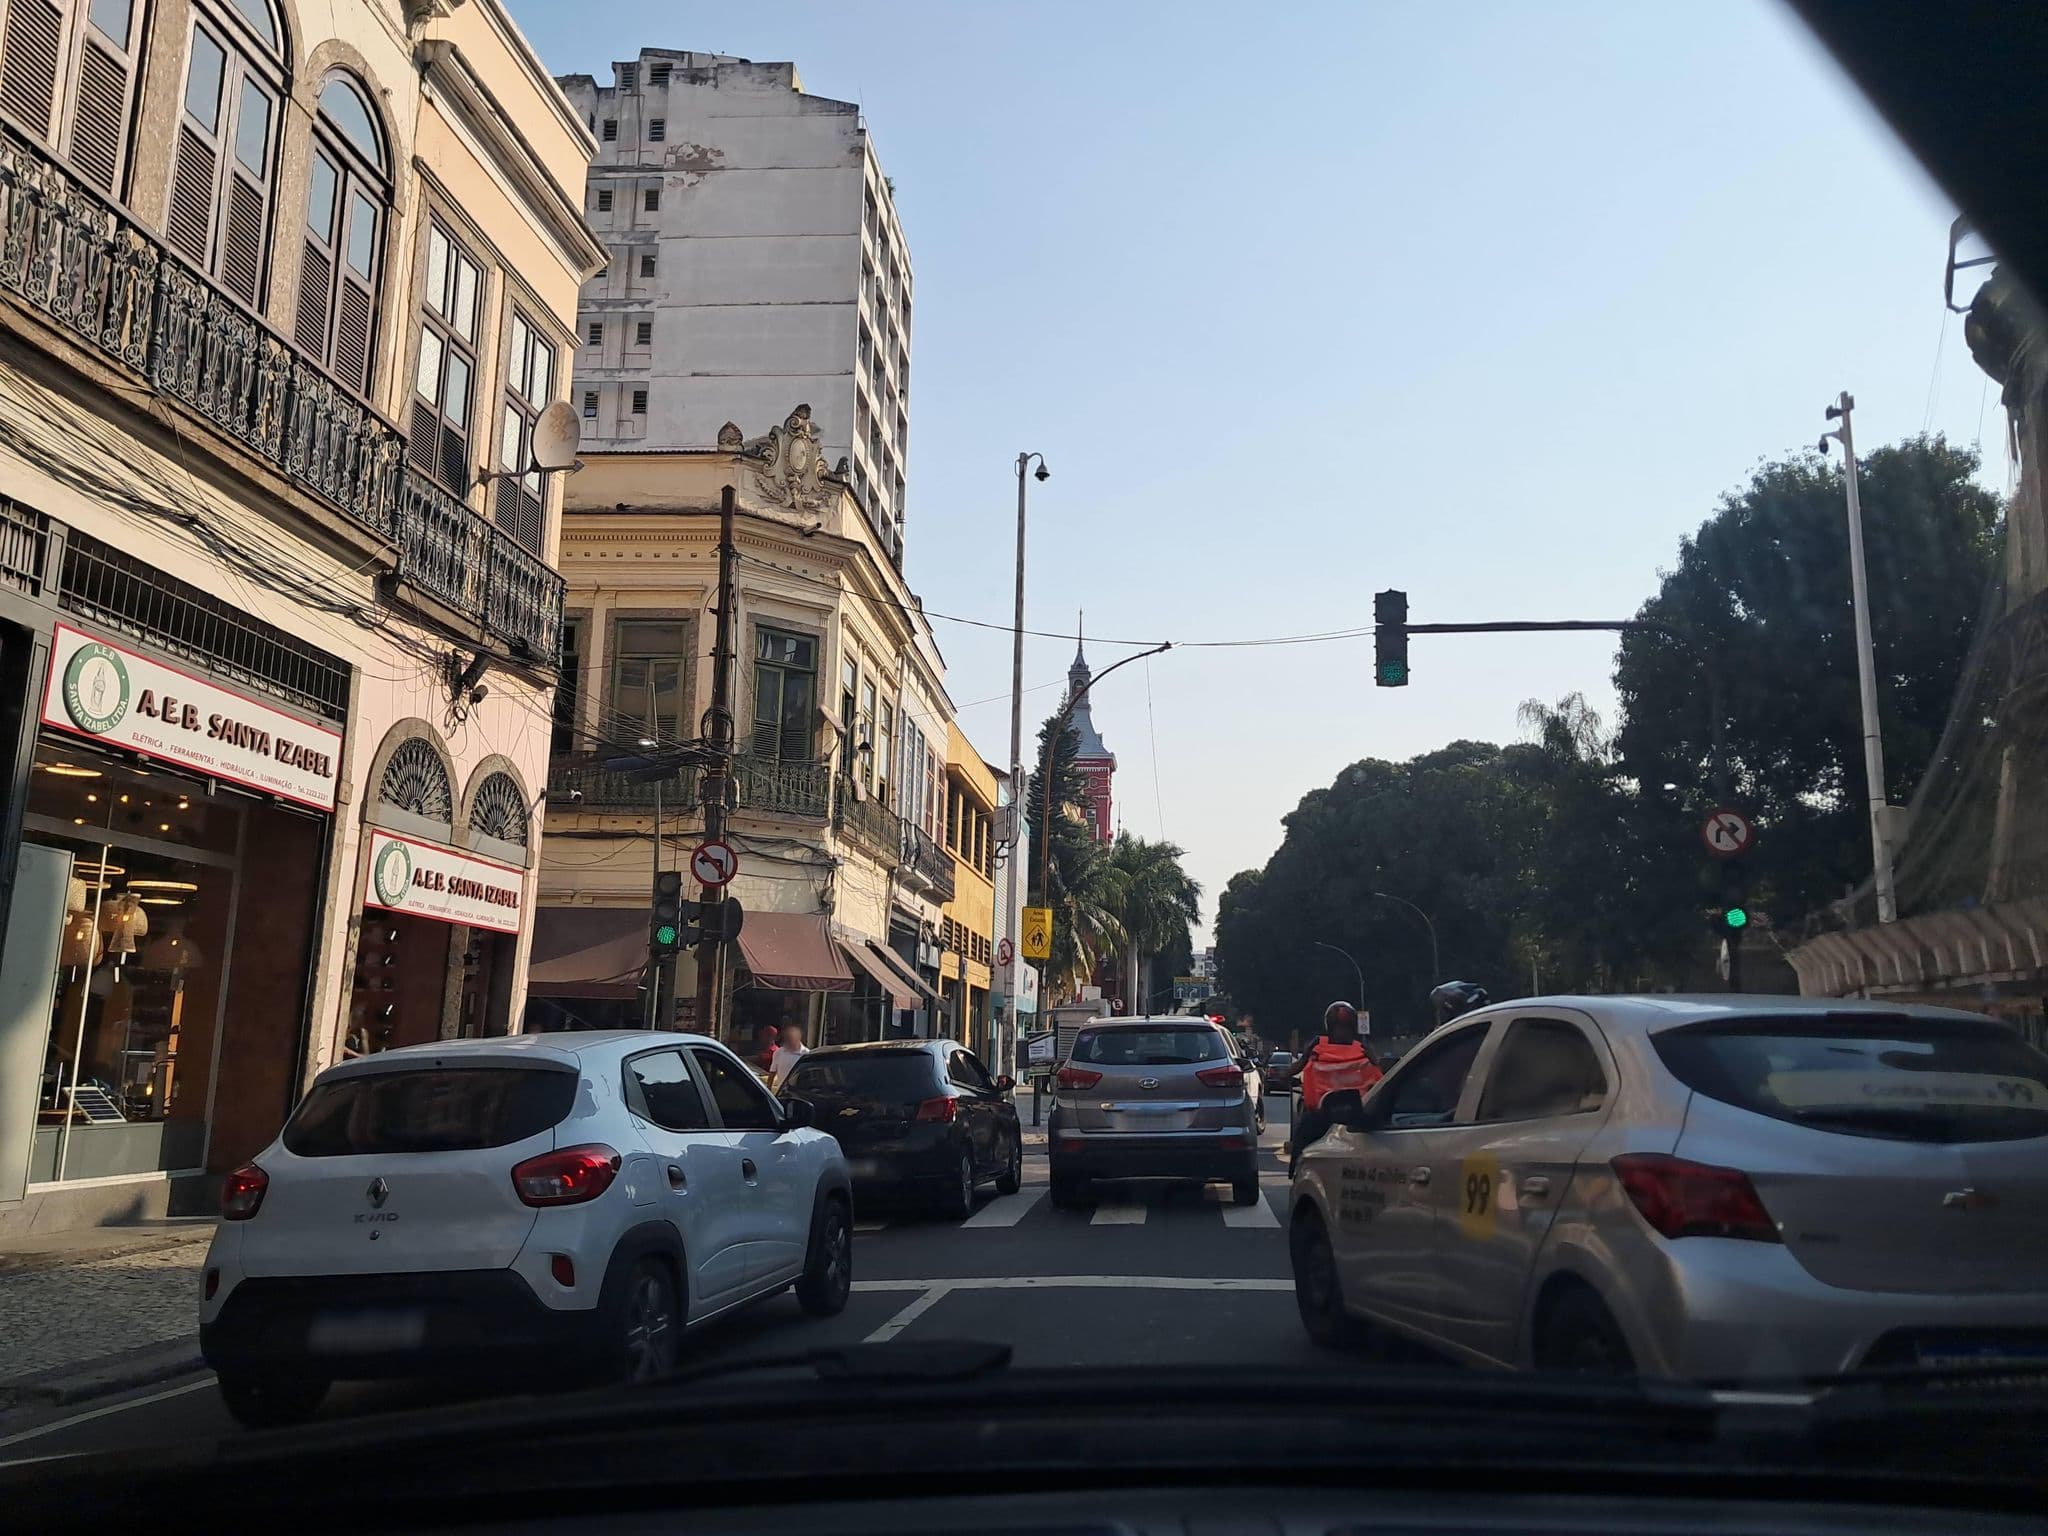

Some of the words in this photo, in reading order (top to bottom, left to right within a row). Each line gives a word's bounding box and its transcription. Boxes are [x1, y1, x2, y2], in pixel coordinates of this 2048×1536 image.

[69, 682, 85, 719] SANTA
[83, 716, 113, 731] IZABEL
[169, 744, 215, 766] FERRAMENTAS
[260, 773, 293, 790] ILUMINAÇÃO
[207, 713, 271, 757] SANTA
[275, 736, 333, 778] IZABEL
[447, 875, 484, 901] SANTA
[484, 884, 520, 910] IZABEL
[1466, 1173, 1490, 1216] 99
[354, 1212, 399, 1224] KWID
